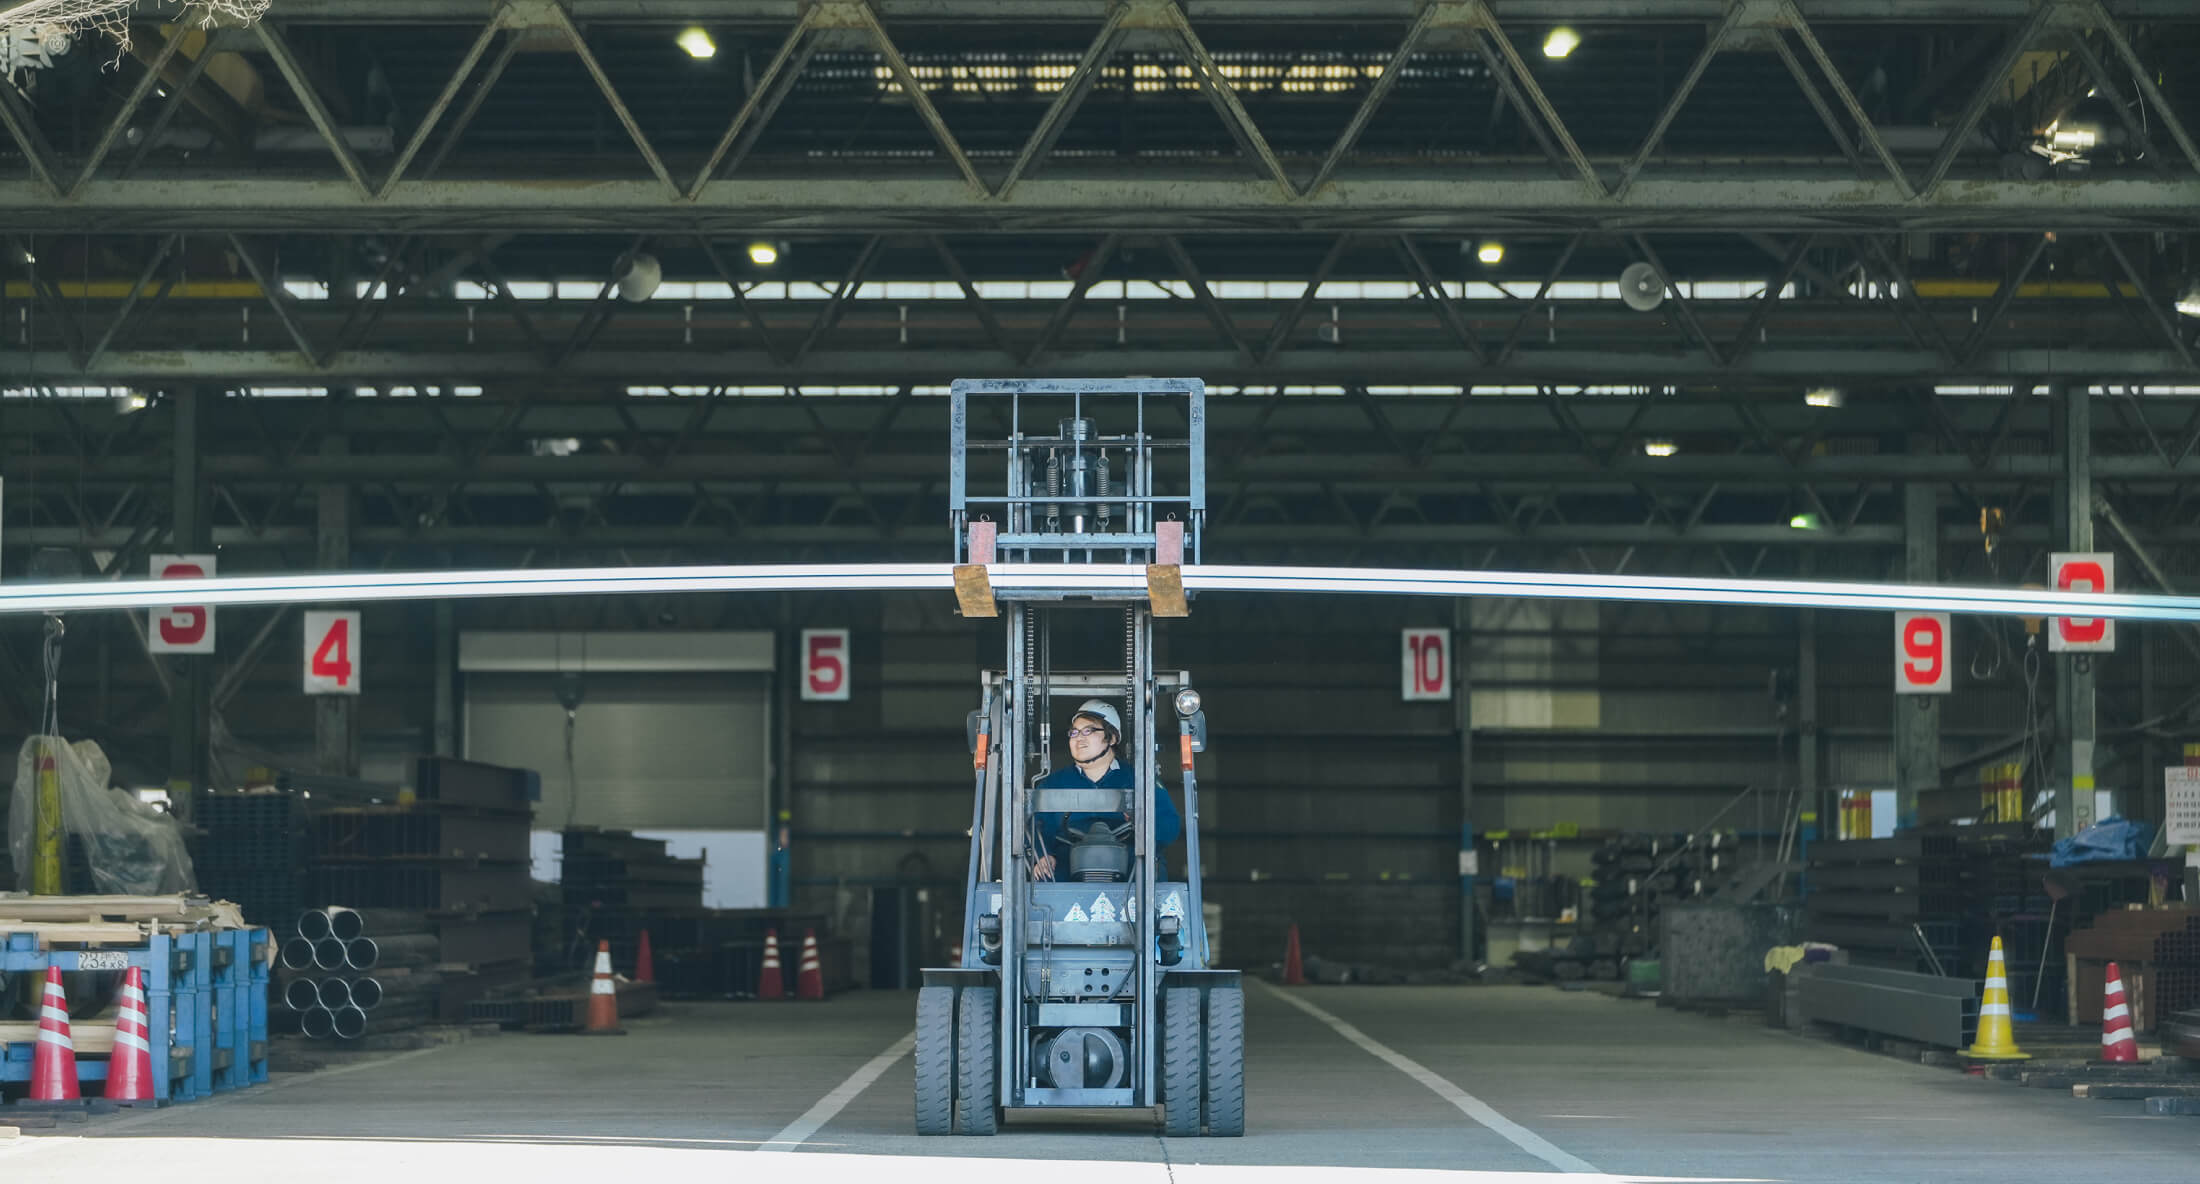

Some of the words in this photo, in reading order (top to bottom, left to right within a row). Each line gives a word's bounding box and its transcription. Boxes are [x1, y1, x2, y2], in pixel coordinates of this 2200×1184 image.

[312, 618, 352, 686] 4
[809, 635, 843, 694] 5
[1409, 635, 1444, 693] 10
[1903, 616, 1943, 685] 9
